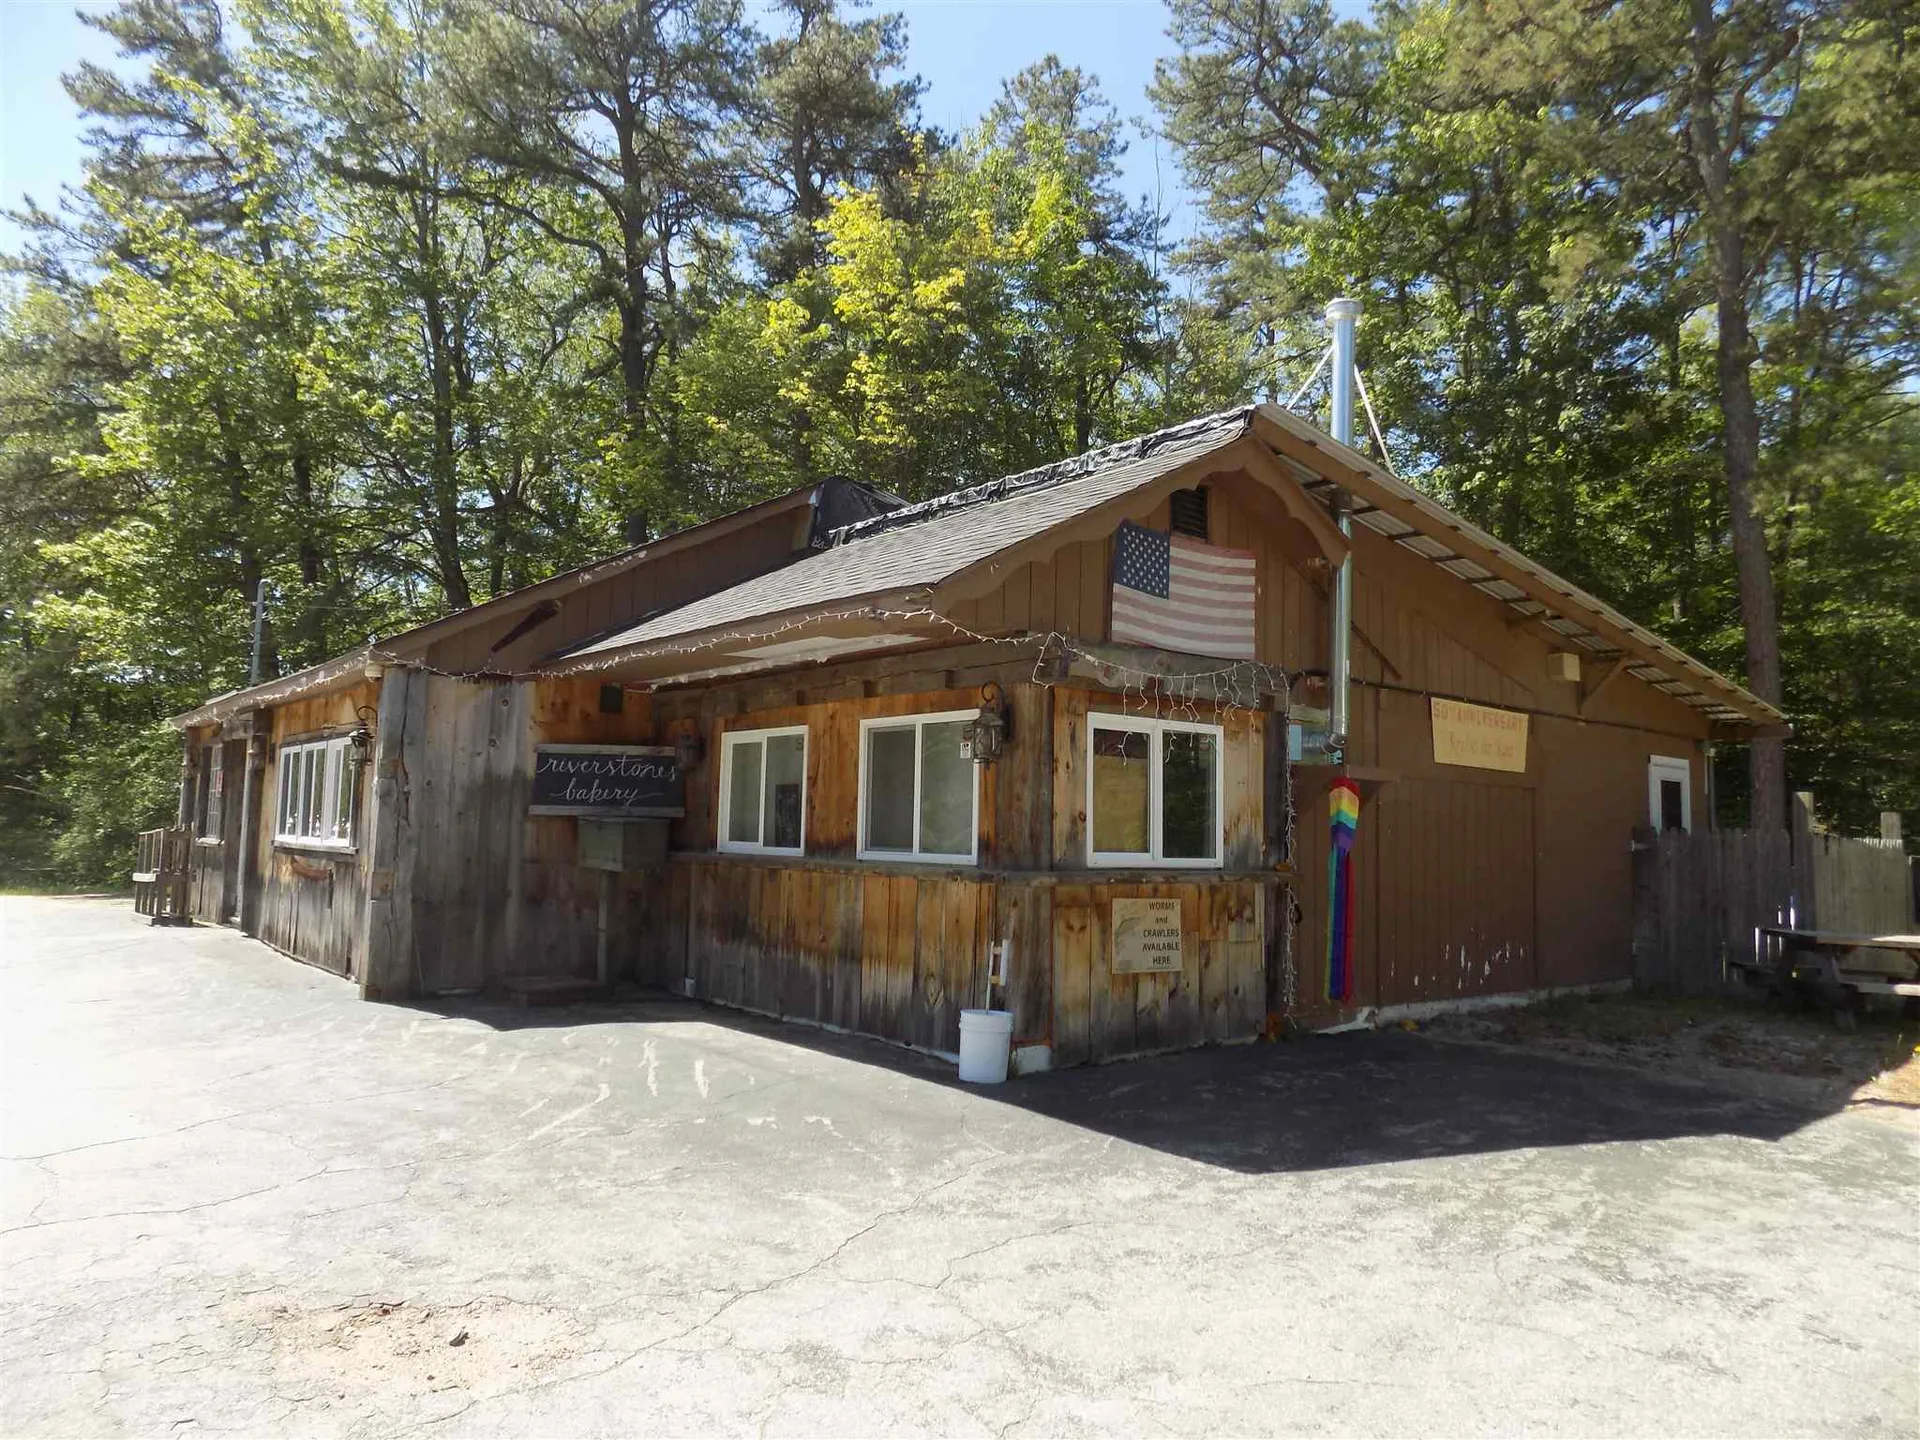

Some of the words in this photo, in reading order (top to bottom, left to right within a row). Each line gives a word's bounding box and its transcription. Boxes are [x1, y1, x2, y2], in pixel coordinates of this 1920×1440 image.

[552, 777, 653, 808] bakery
[1149, 901, 1175, 910] WORMS
[1155, 916, 1168, 924] and
[1143, 929, 1180, 938] CRAWLERS
[1142, 942, 1180, 951] AVAILABLE
[1153, 956, 1171, 965] HERE
